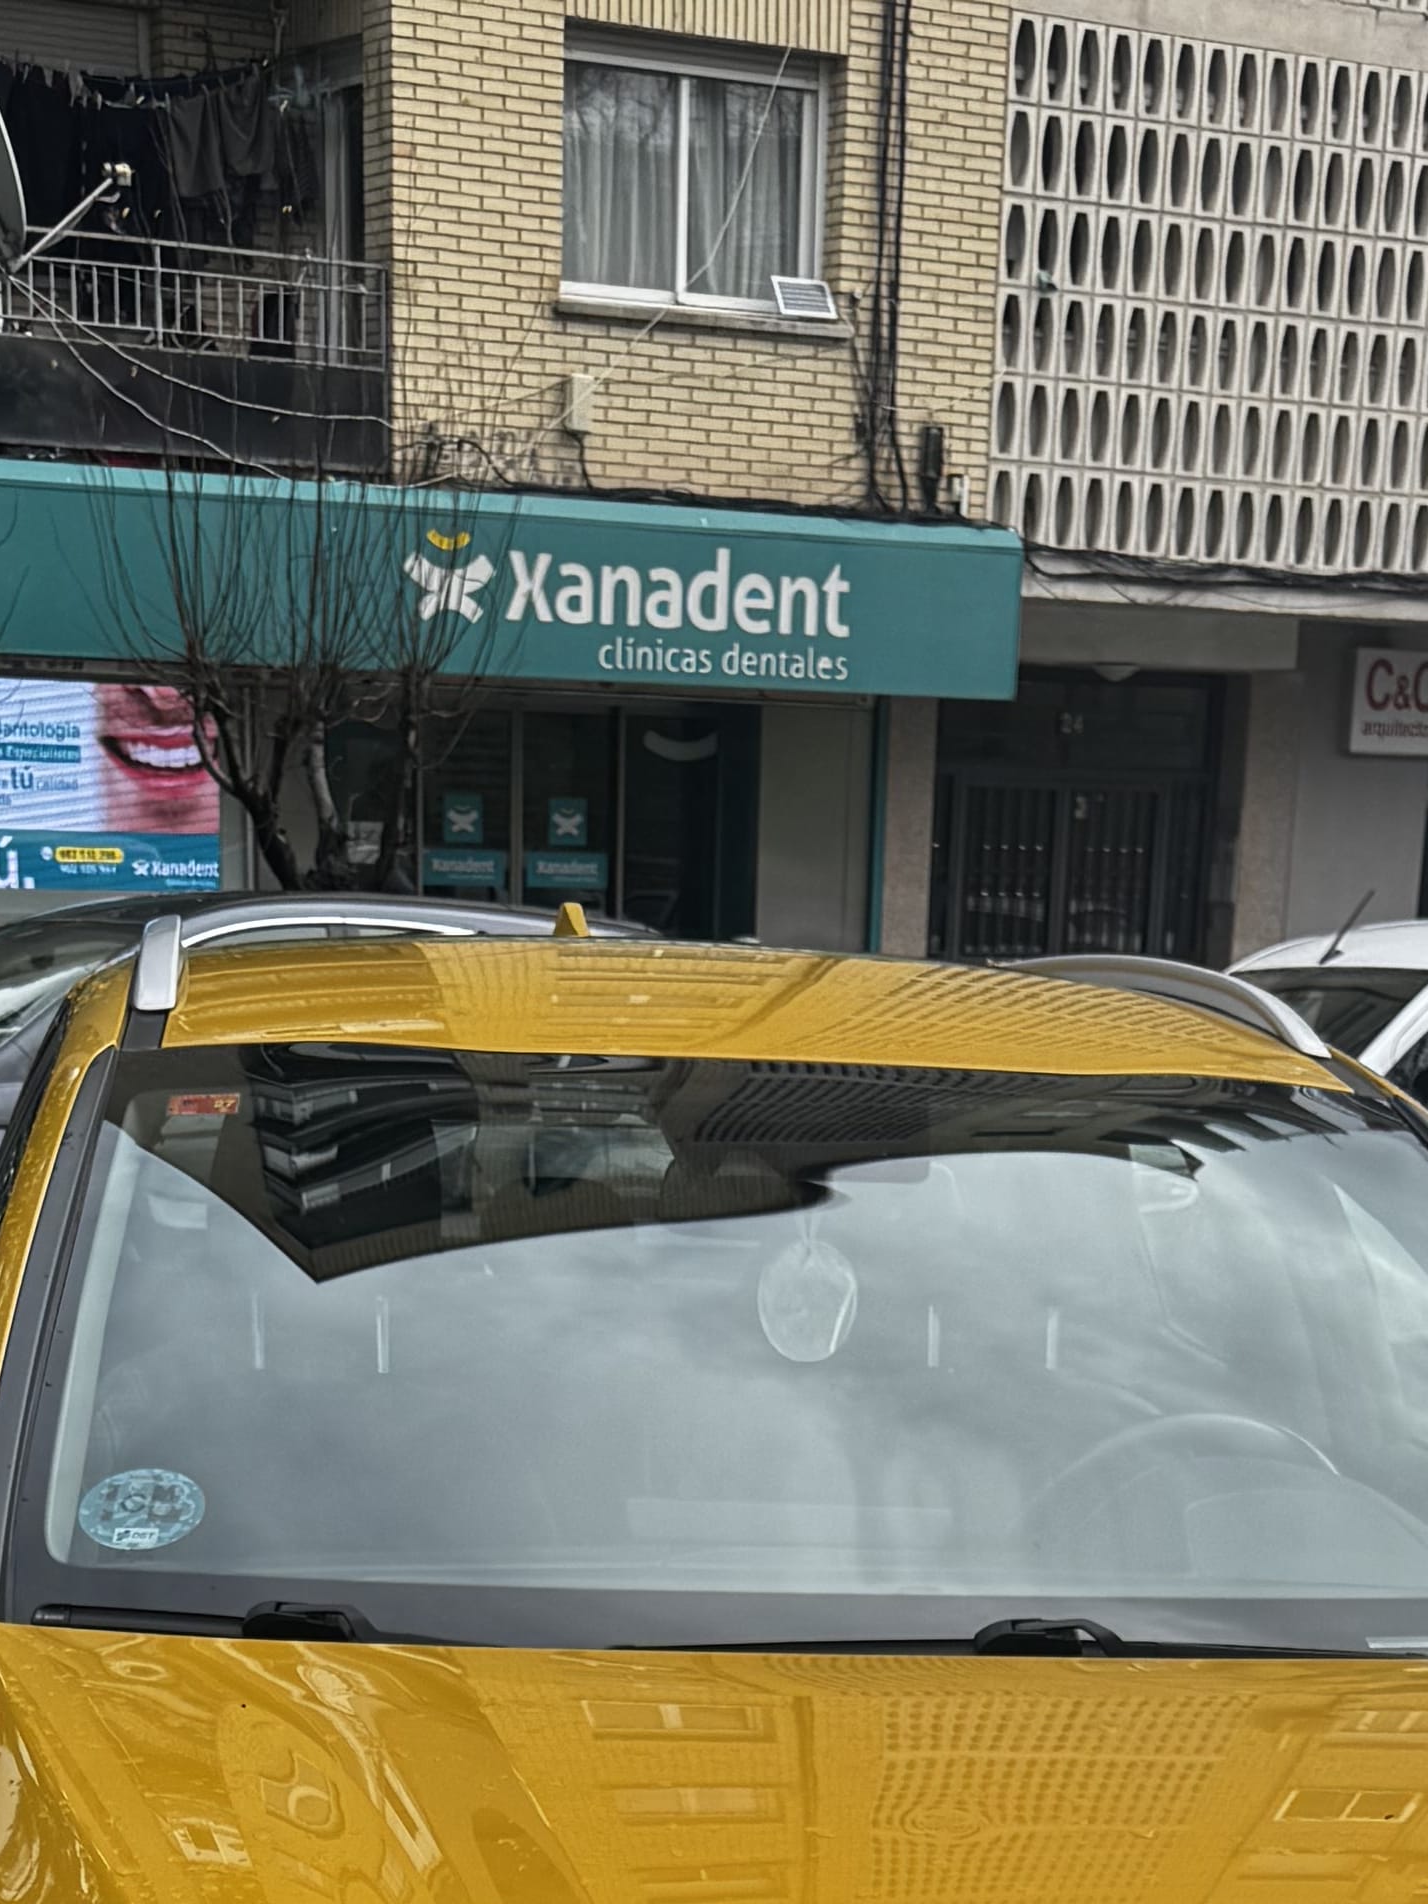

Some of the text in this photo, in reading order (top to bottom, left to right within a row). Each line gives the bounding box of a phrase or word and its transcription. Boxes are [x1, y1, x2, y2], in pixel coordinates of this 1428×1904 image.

[505, 547, 851, 638] Xanadent
[597, 636, 849, 681] clínicas dentales
